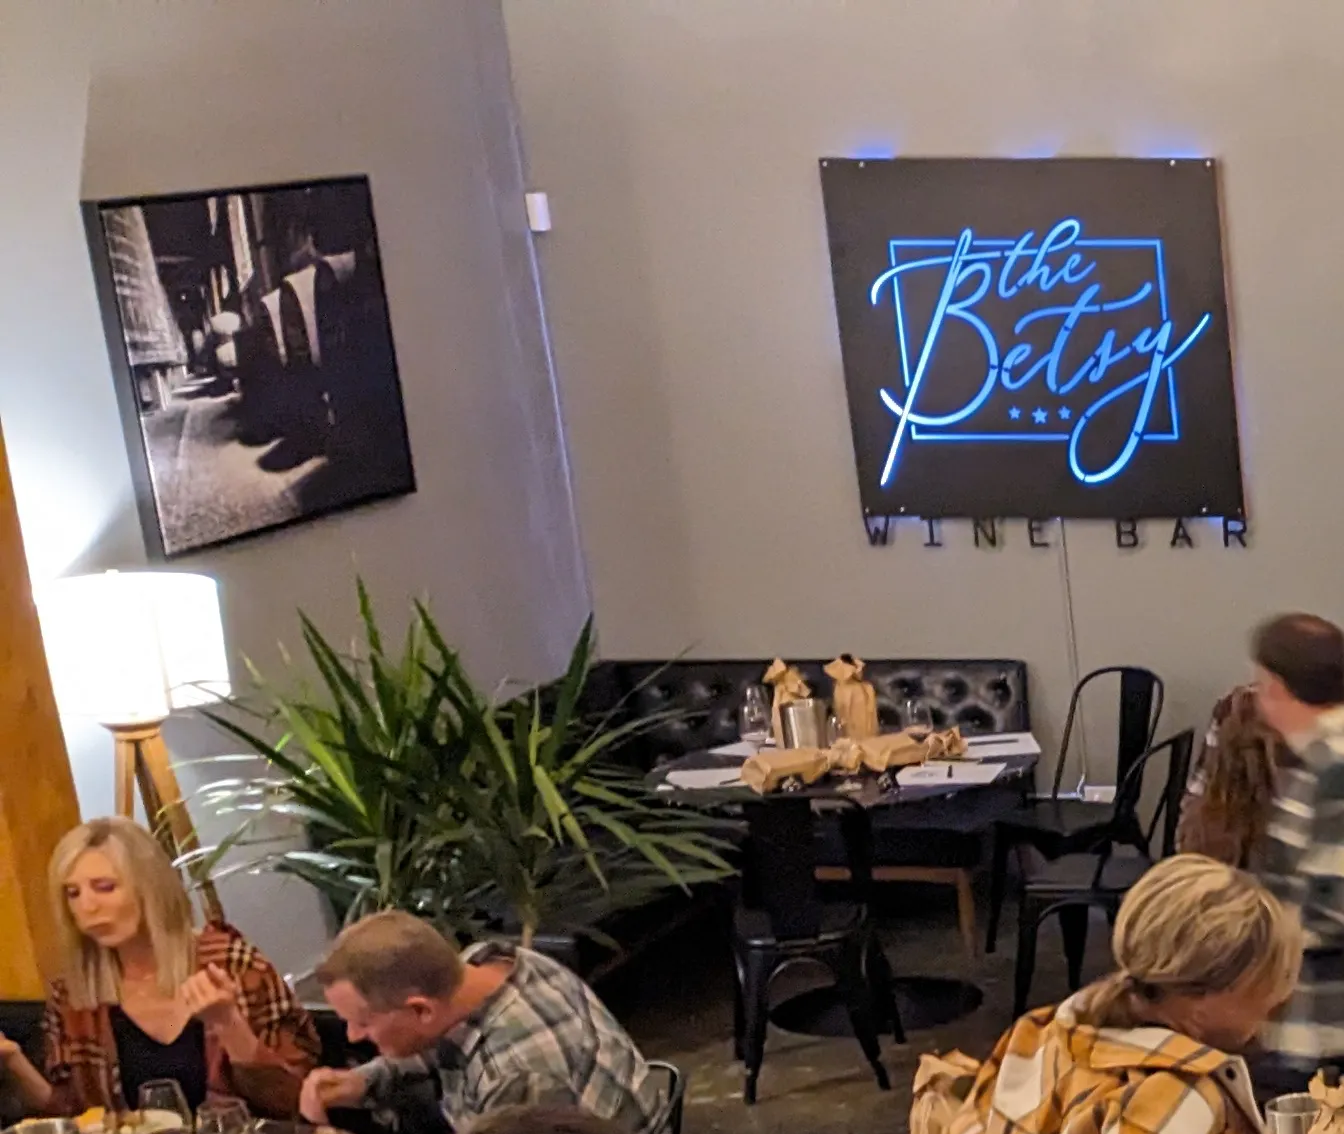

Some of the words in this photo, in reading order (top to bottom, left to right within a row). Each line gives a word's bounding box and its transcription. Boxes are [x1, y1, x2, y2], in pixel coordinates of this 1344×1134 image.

[998, 218, 1096, 298] the
[871, 226, 1210, 487] Betsy
[863, 515, 1050, 547] WINE
[1115, 515, 1248, 547] BAR
